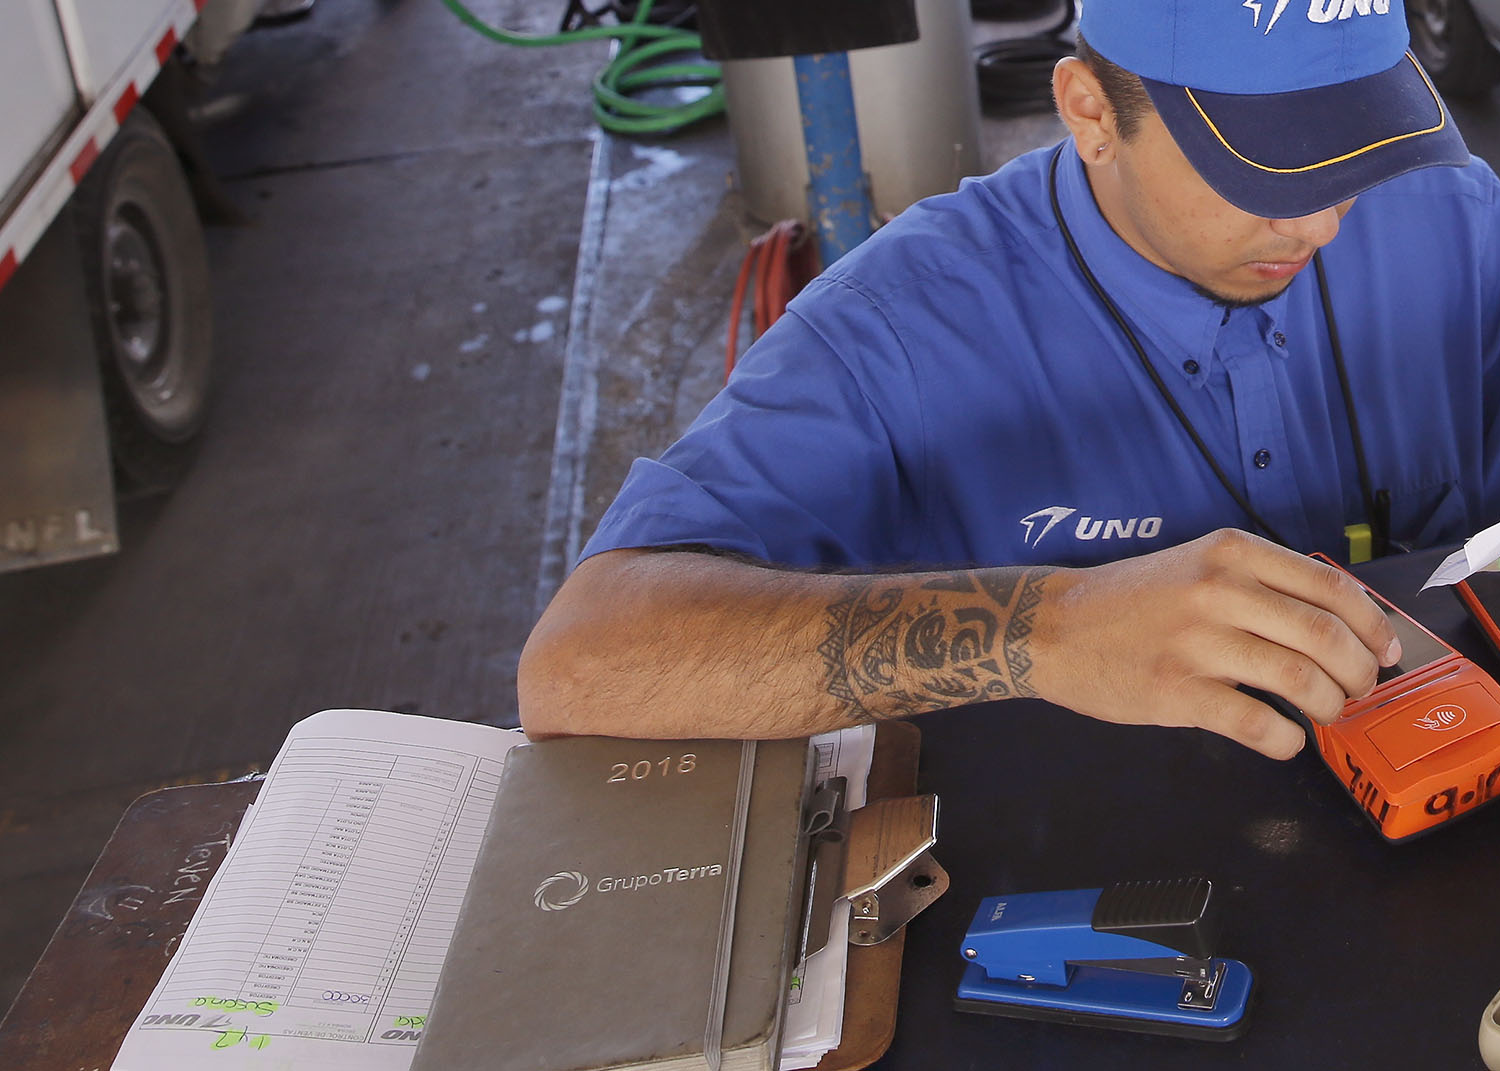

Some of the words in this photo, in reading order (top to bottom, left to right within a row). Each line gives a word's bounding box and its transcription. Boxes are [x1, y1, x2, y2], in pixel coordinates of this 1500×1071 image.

[1075, 516, 1164, 541] UNO
[606, 753, 698, 783] 2018
[596, 863, 722, 891] GrupoTerra
[139, 1014, 200, 1027] UNO
